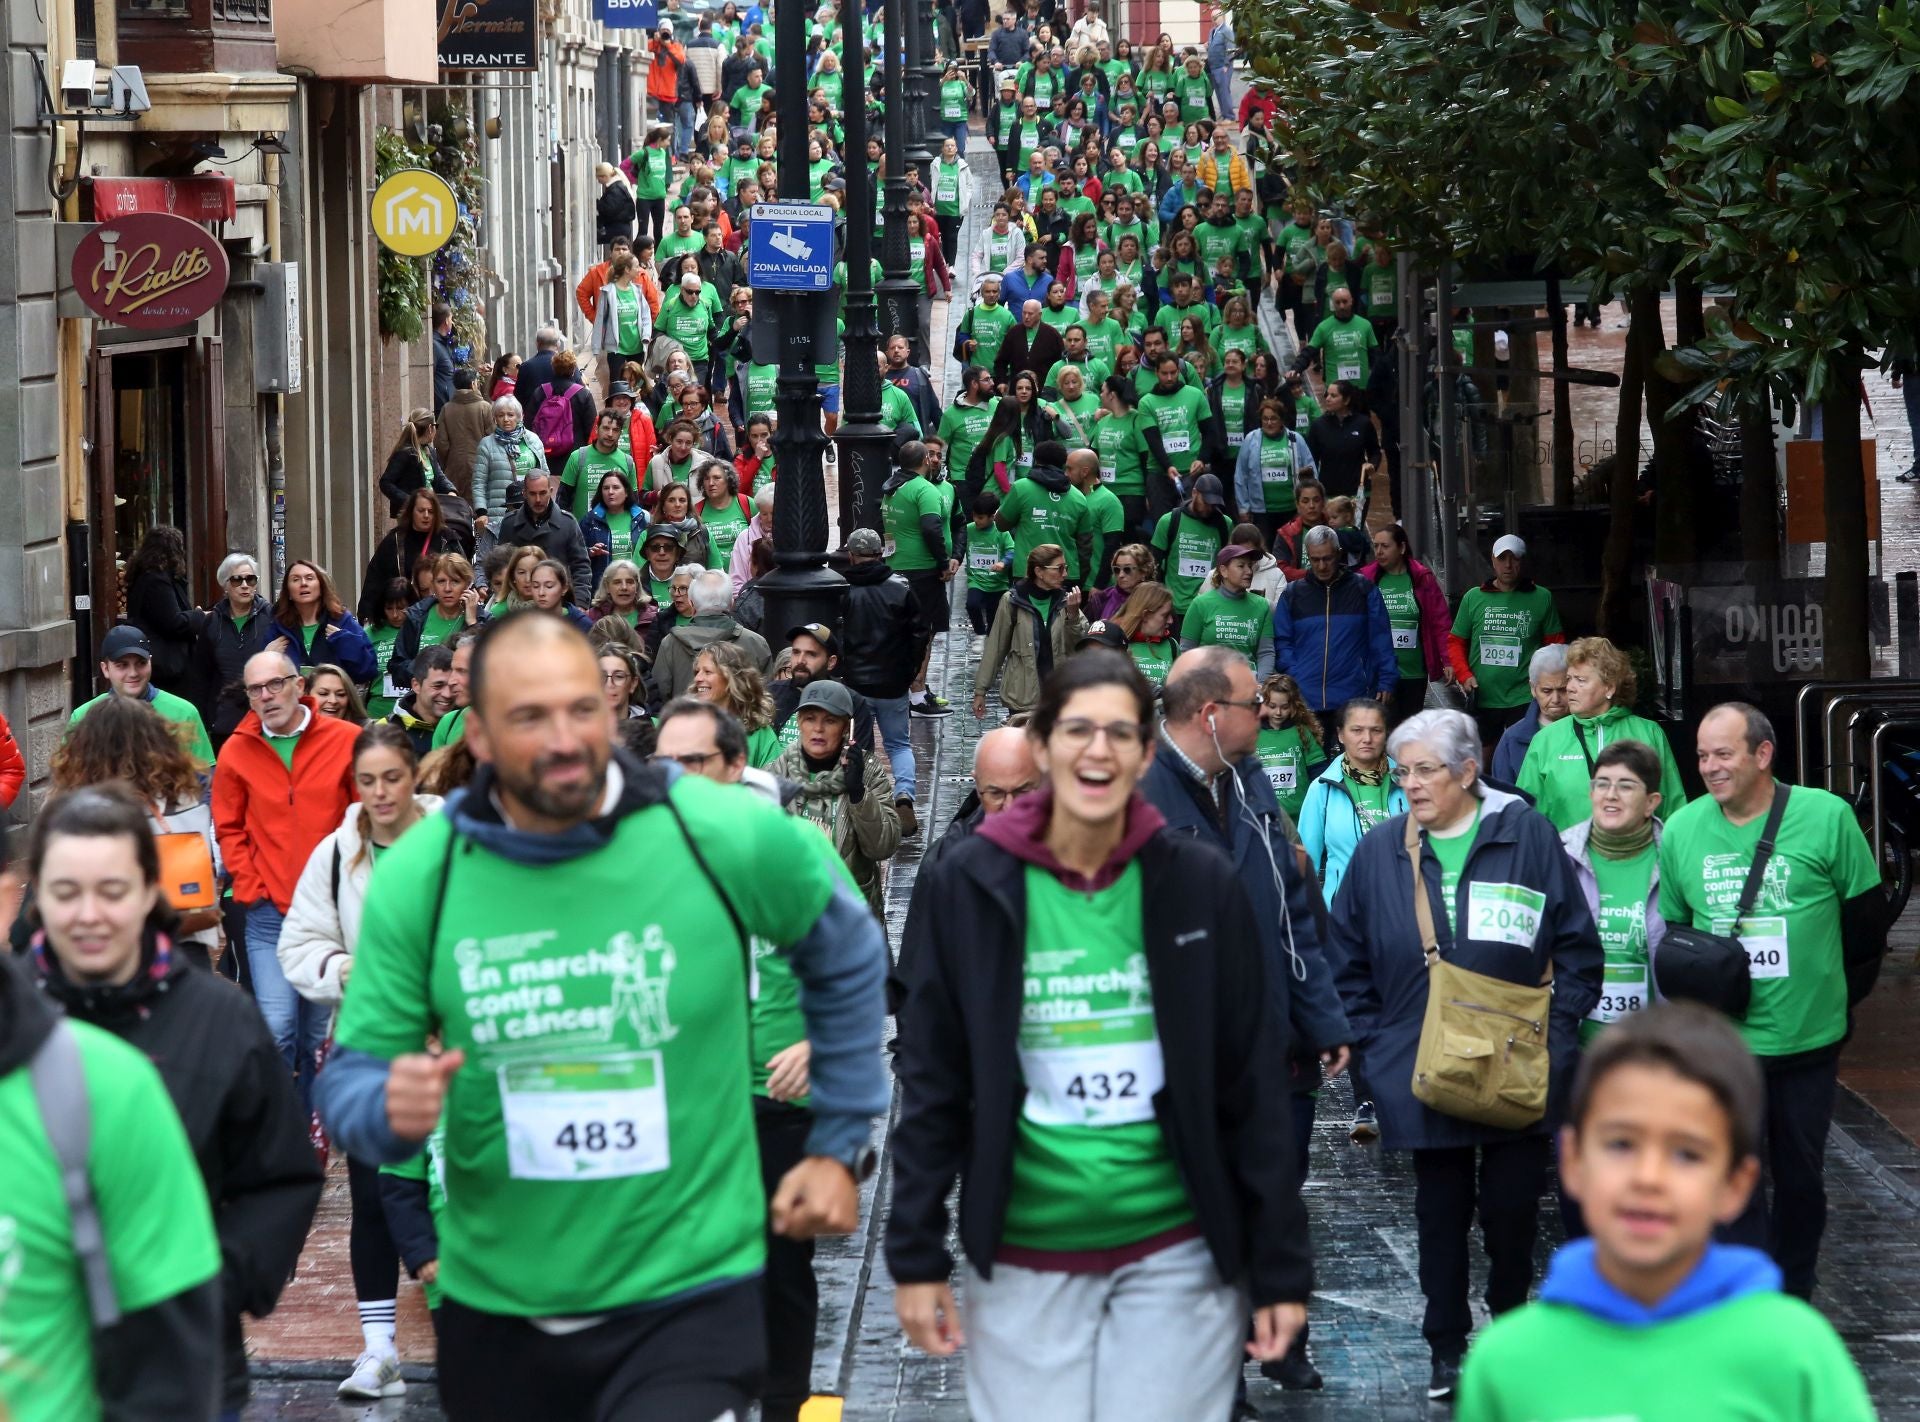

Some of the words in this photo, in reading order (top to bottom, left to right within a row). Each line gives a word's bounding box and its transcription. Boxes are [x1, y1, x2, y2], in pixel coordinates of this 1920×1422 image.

[768, 208, 797, 216] POLICIA
[799, 209, 824, 217] LOCAL
[753, 263, 781, 272] ZONA
[782, 264, 828, 273] VIGILADA
[91, 243, 212, 306] Rialto
[142, 306, 167, 316] desde
[170, 306, 191, 316] 1926
[976, 558, 995, 566] 1381
[1189, 564, 1206, 573] 175
[1491, 624, 1517, 633] cáncer
[1224, 632, 1249, 640] cáncer
[1396, 635, 1409, 643] 46
[1484, 648, 1515, 660] 2094
[1703, 867, 1721, 879] En
[1704, 879, 1743, 892] contra
[1706, 894, 1716, 905] el
[1479, 907, 1536, 937] 2048
[458, 964, 501, 993] En
[508, 948, 630, 985] marcha
[465, 984, 564, 1018] contra
[471, 1017, 499, 1044] el
[504, 1005, 613, 1042] cáncer
[1066, 1071, 1137, 1101] 432
[556, 1121, 638, 1152] 483
